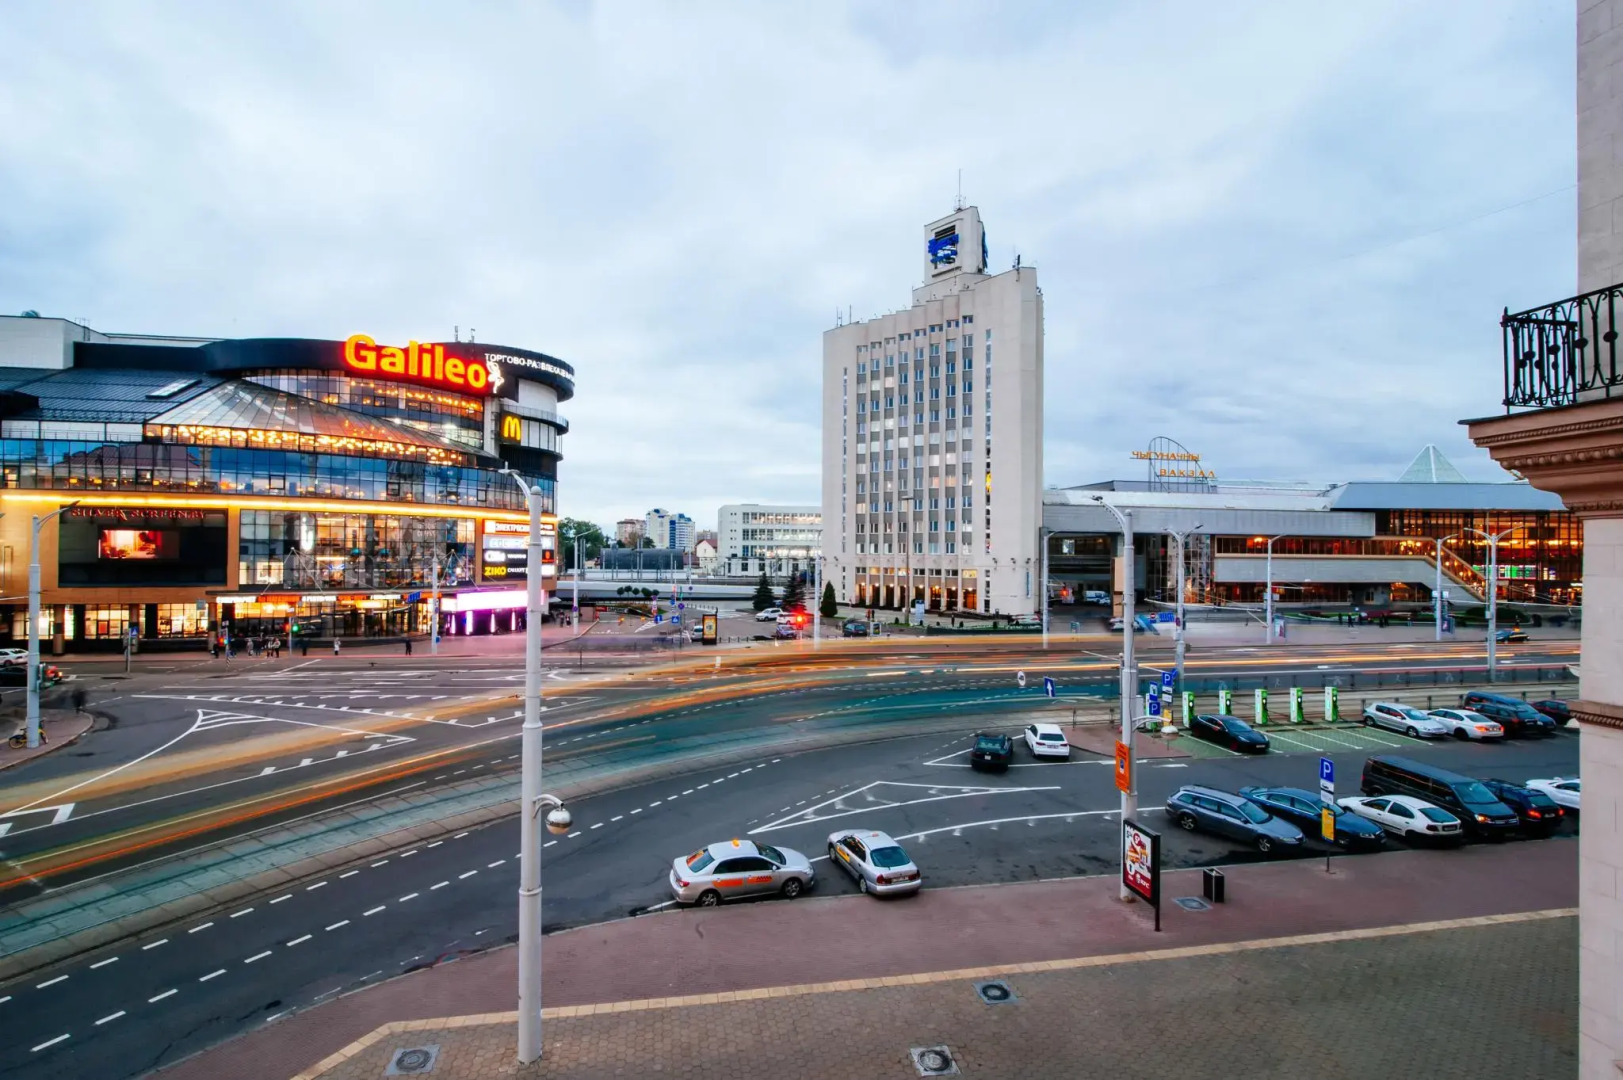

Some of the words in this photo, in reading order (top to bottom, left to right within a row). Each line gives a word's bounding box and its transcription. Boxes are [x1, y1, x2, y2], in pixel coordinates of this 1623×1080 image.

[344, 333, 487, 389] Galileo
[1131, 451, 1200, 461] ЧЫГУНАЧНЫ
[1159, 468, 1215, 478] ВАКЗАЛ
[71, 507, 127, 520] SILVER
[484, 566, 507, 576] ZIKO
[1164, 673, 1171, 685] P
[1151, 703, 1159, 714] P
[1323, 761, 1332, 778] P
